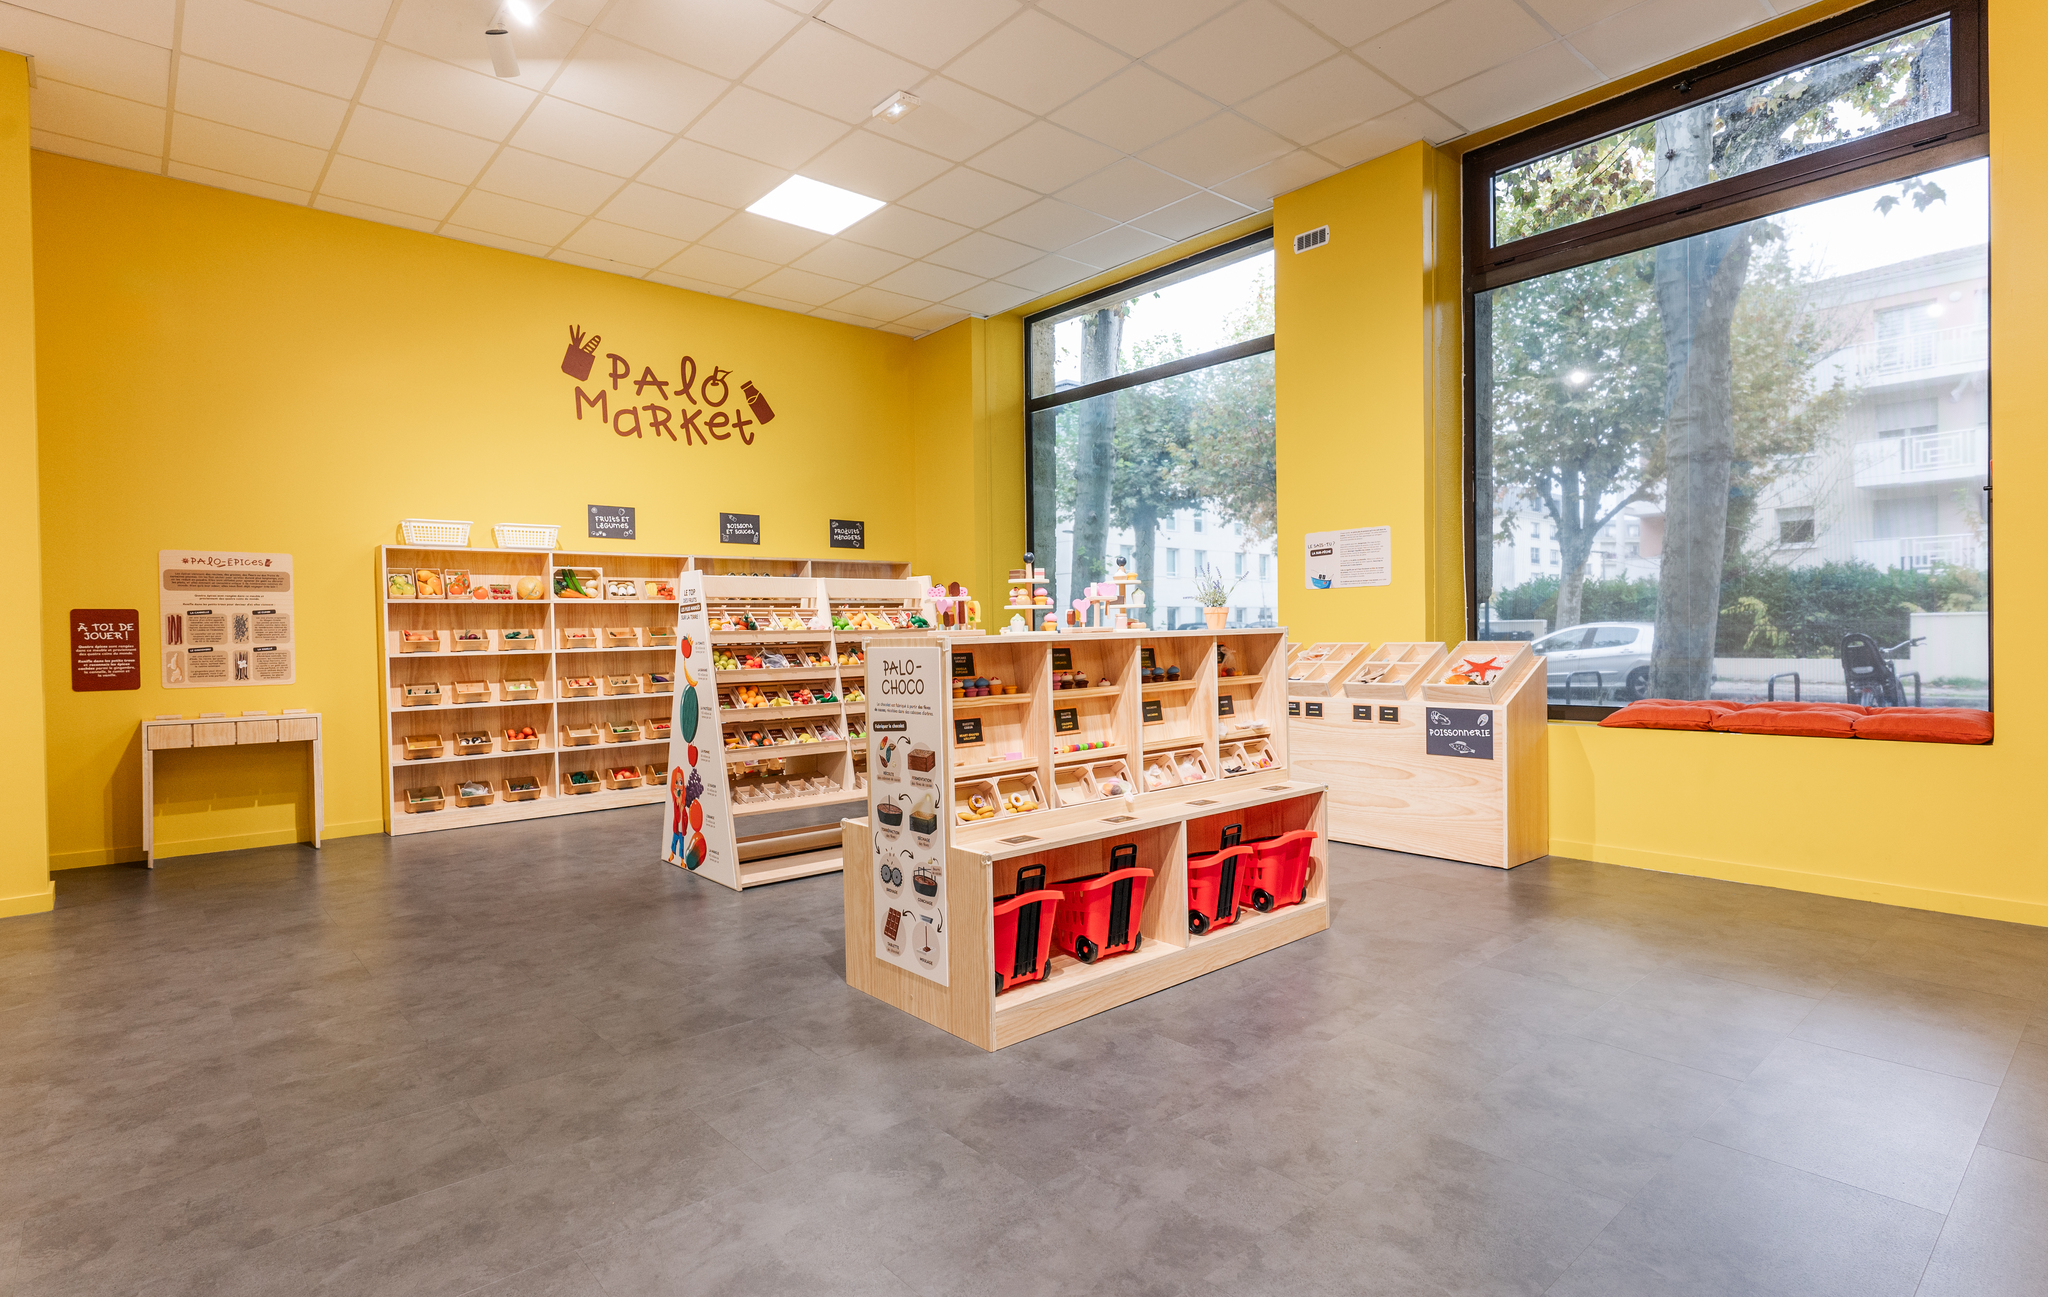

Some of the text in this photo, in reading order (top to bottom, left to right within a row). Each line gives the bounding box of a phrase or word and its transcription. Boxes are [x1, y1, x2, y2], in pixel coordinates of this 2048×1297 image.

[77, 623, 88, 632] À
[84, 632, 123, 640] JOUER
[882, 659, 922, 676] PALO-
[881, 679, 924, 695] CHOCO
